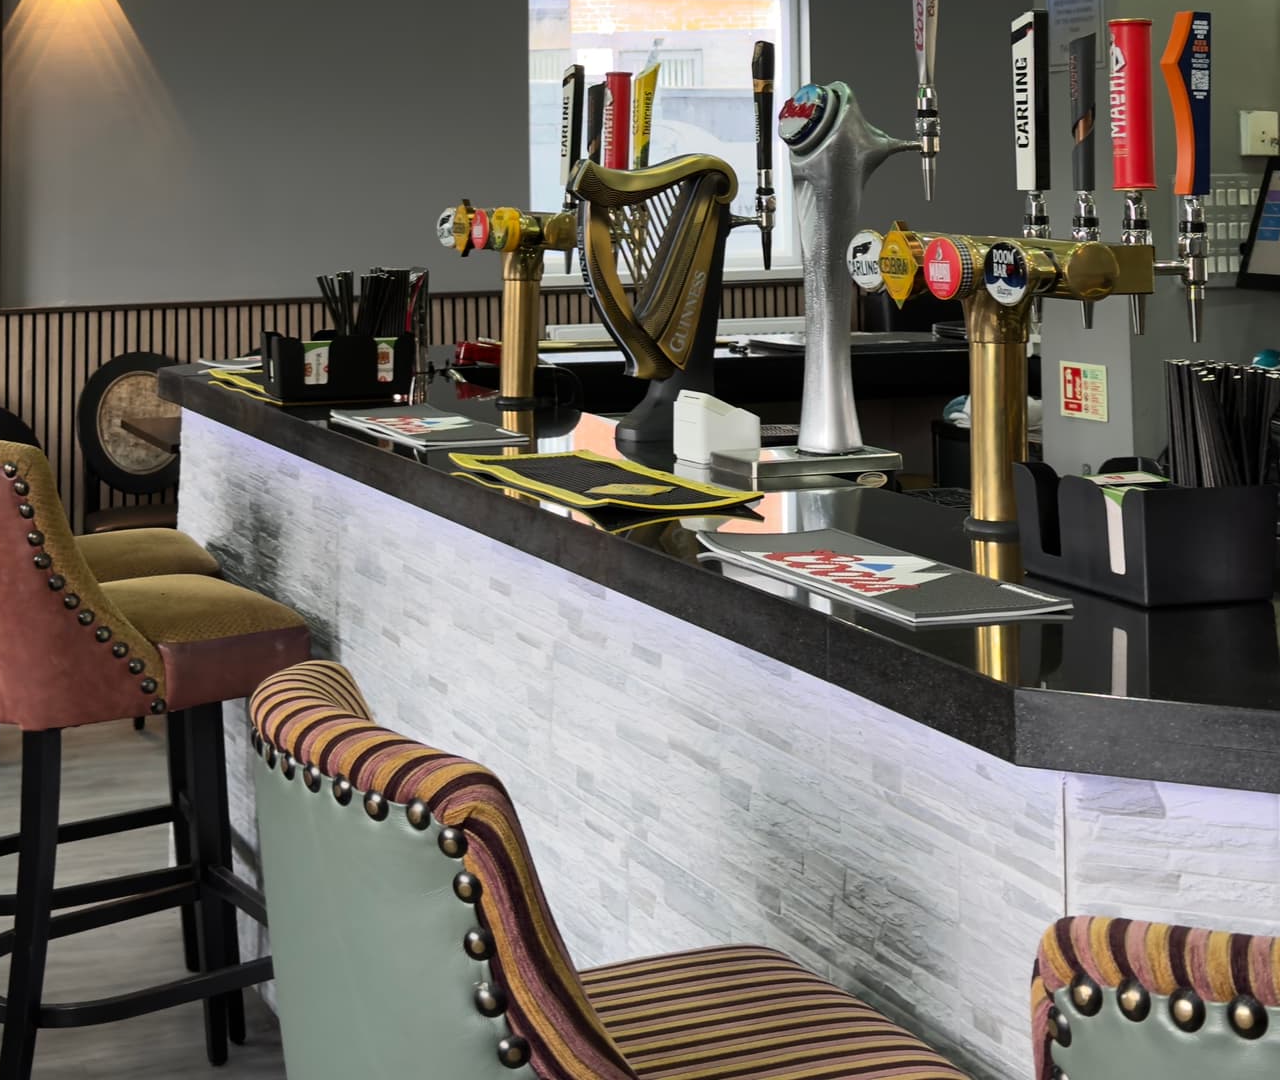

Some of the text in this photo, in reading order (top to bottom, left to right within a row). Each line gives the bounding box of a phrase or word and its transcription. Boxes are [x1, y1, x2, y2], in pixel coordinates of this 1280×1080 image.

[561, 95, 570, 158] CARLING
[1015, 56, 1030, 149] CARLING
[992, 247, 1016, 264] DOOM
[992, 265, 1009, 278] BAR
[669, 270, 707, 353] GUINNESS
